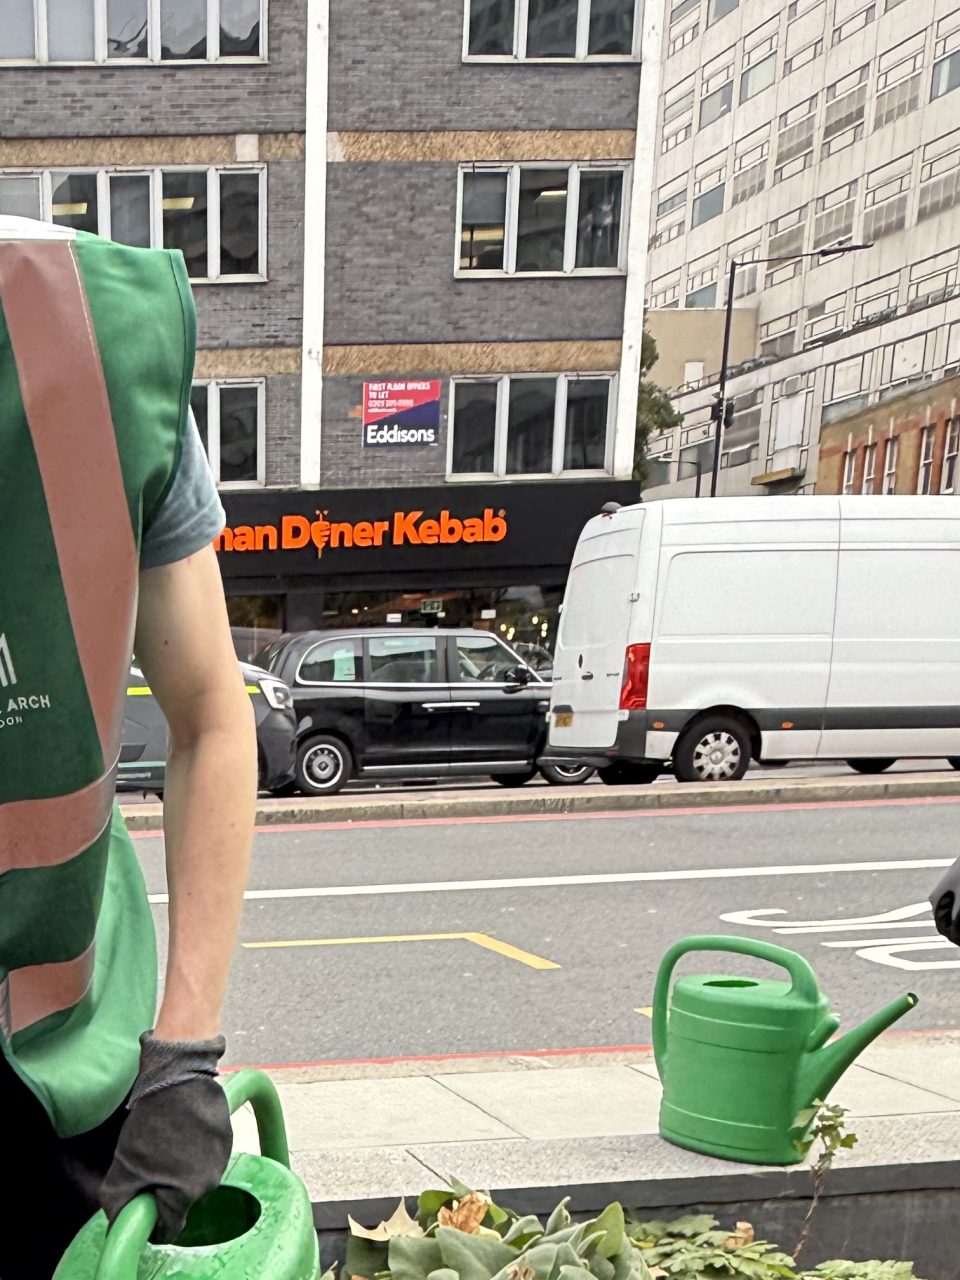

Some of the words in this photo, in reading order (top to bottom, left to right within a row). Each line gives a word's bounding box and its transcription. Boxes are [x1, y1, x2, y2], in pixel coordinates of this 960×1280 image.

[378, 391, 389, 399] LET
[367, 424, 435, 444] Eddisons
[392, 507, 508, 545] Kebab
[7, 695, 51, 712] ARCH
